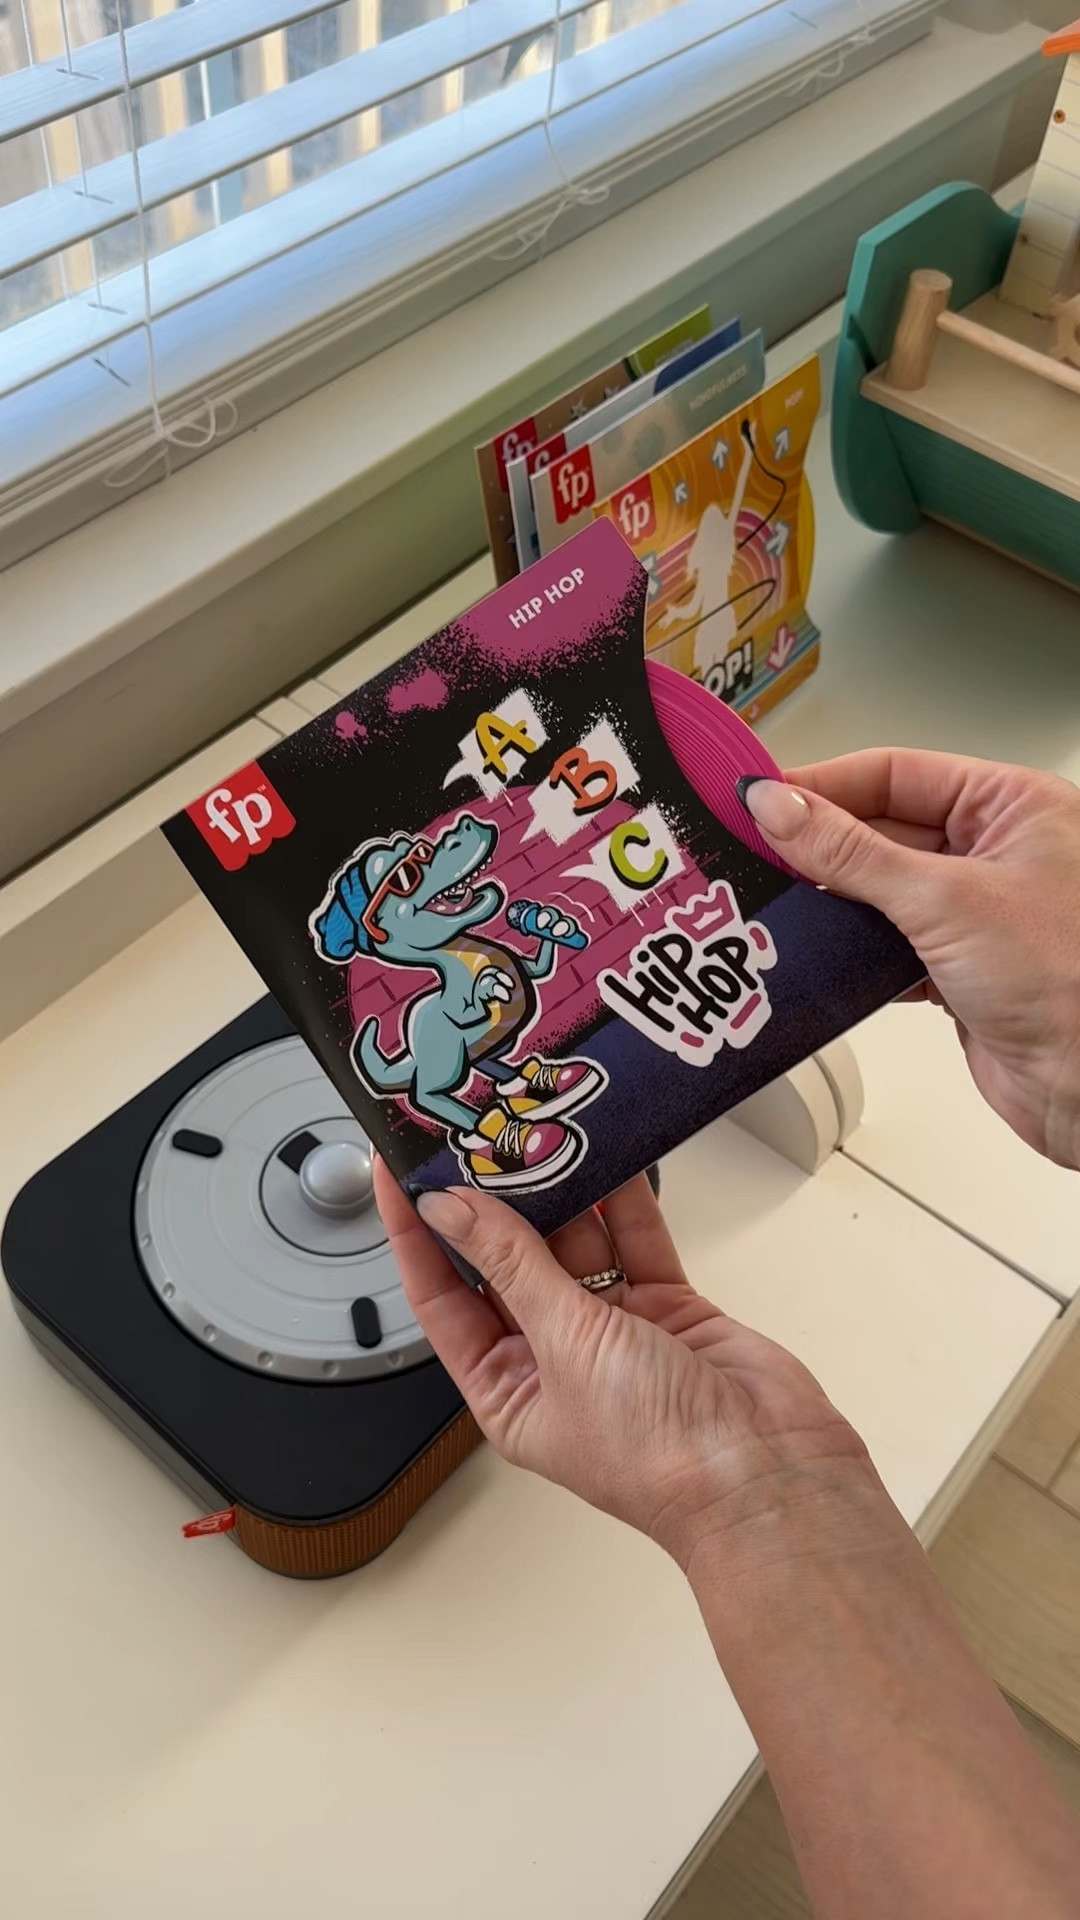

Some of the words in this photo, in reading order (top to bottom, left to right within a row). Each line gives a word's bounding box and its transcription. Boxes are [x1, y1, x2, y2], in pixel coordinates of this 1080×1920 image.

[690, 365, 747, 412] MINDFULNESS
[557, 462, 590, 509] fp
[618, 492, 650, 539] fp
[508, 597, 543, 629] HIP
[543, 567, 585, 605] HOP
[690, 638, 754, 699] OP!
[205, 788, 272, 846] fp
[475, 712, 537, 783] A
[549, 747, 618, 815] B
[609, 822, 669, 890] C
